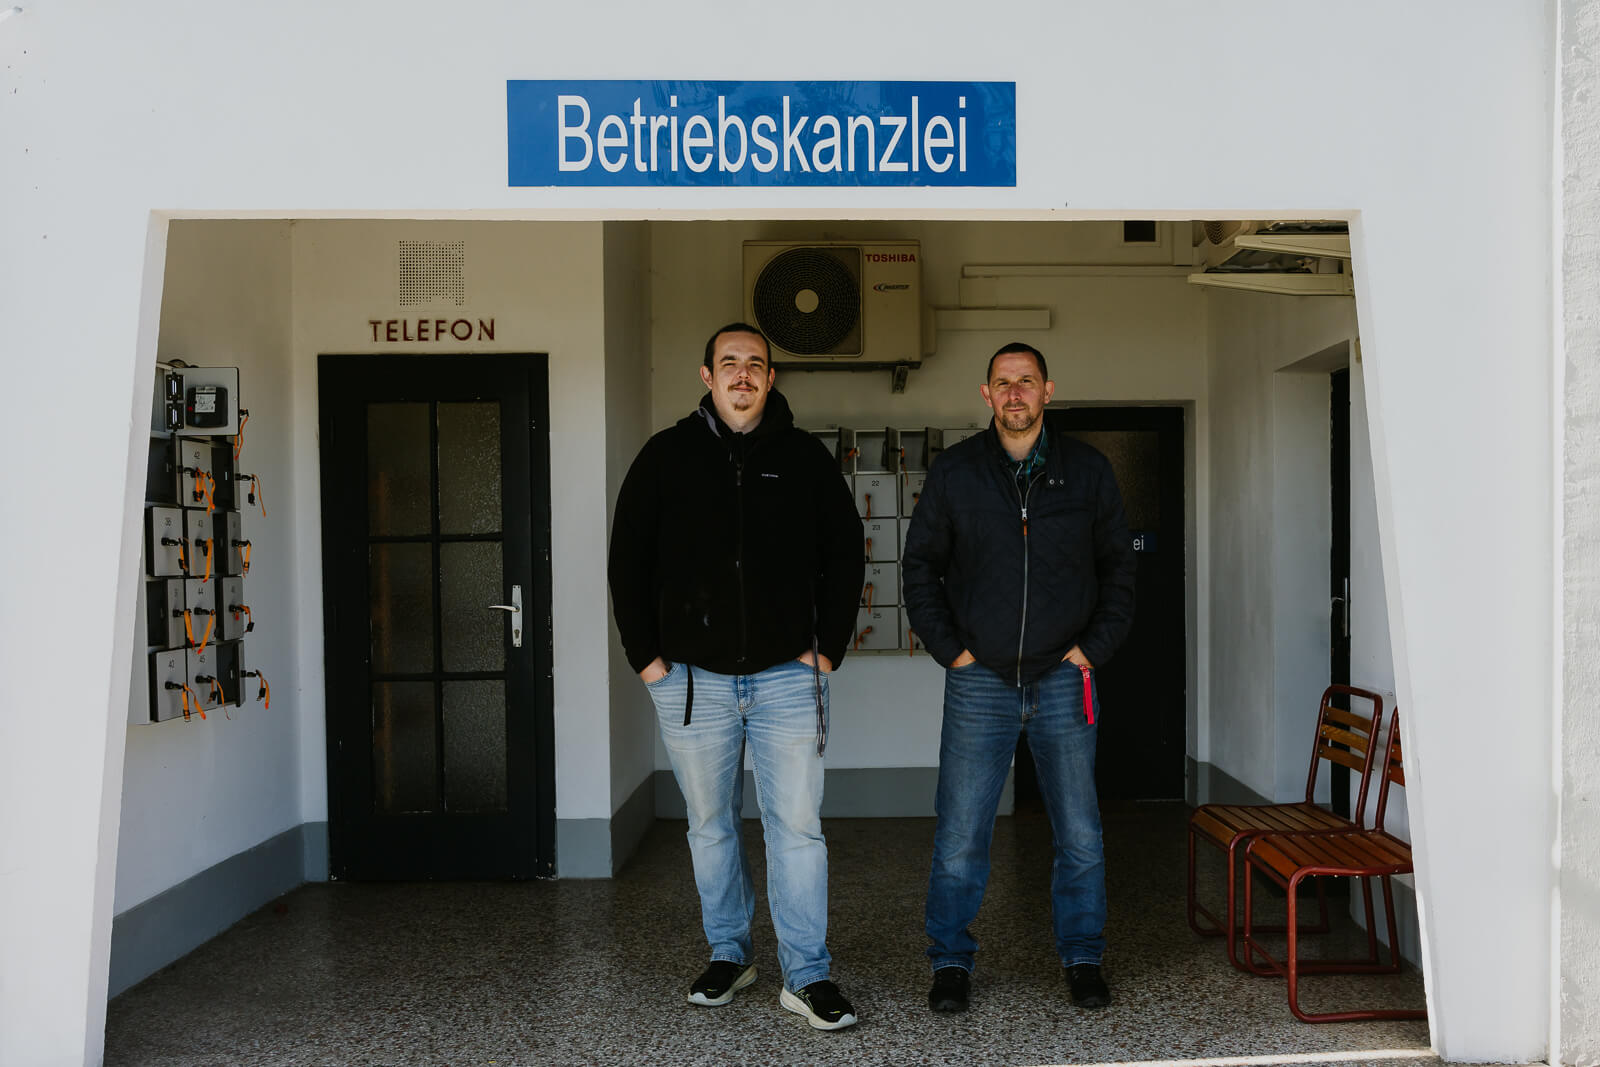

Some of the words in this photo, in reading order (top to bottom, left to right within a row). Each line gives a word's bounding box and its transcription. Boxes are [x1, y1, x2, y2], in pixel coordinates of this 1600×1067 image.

[557, 95, 967, 173] Betriebskanzlei
[865, 253, 916, 263] TOSHIBA
[368, 318, 495, 342] TELEFON
